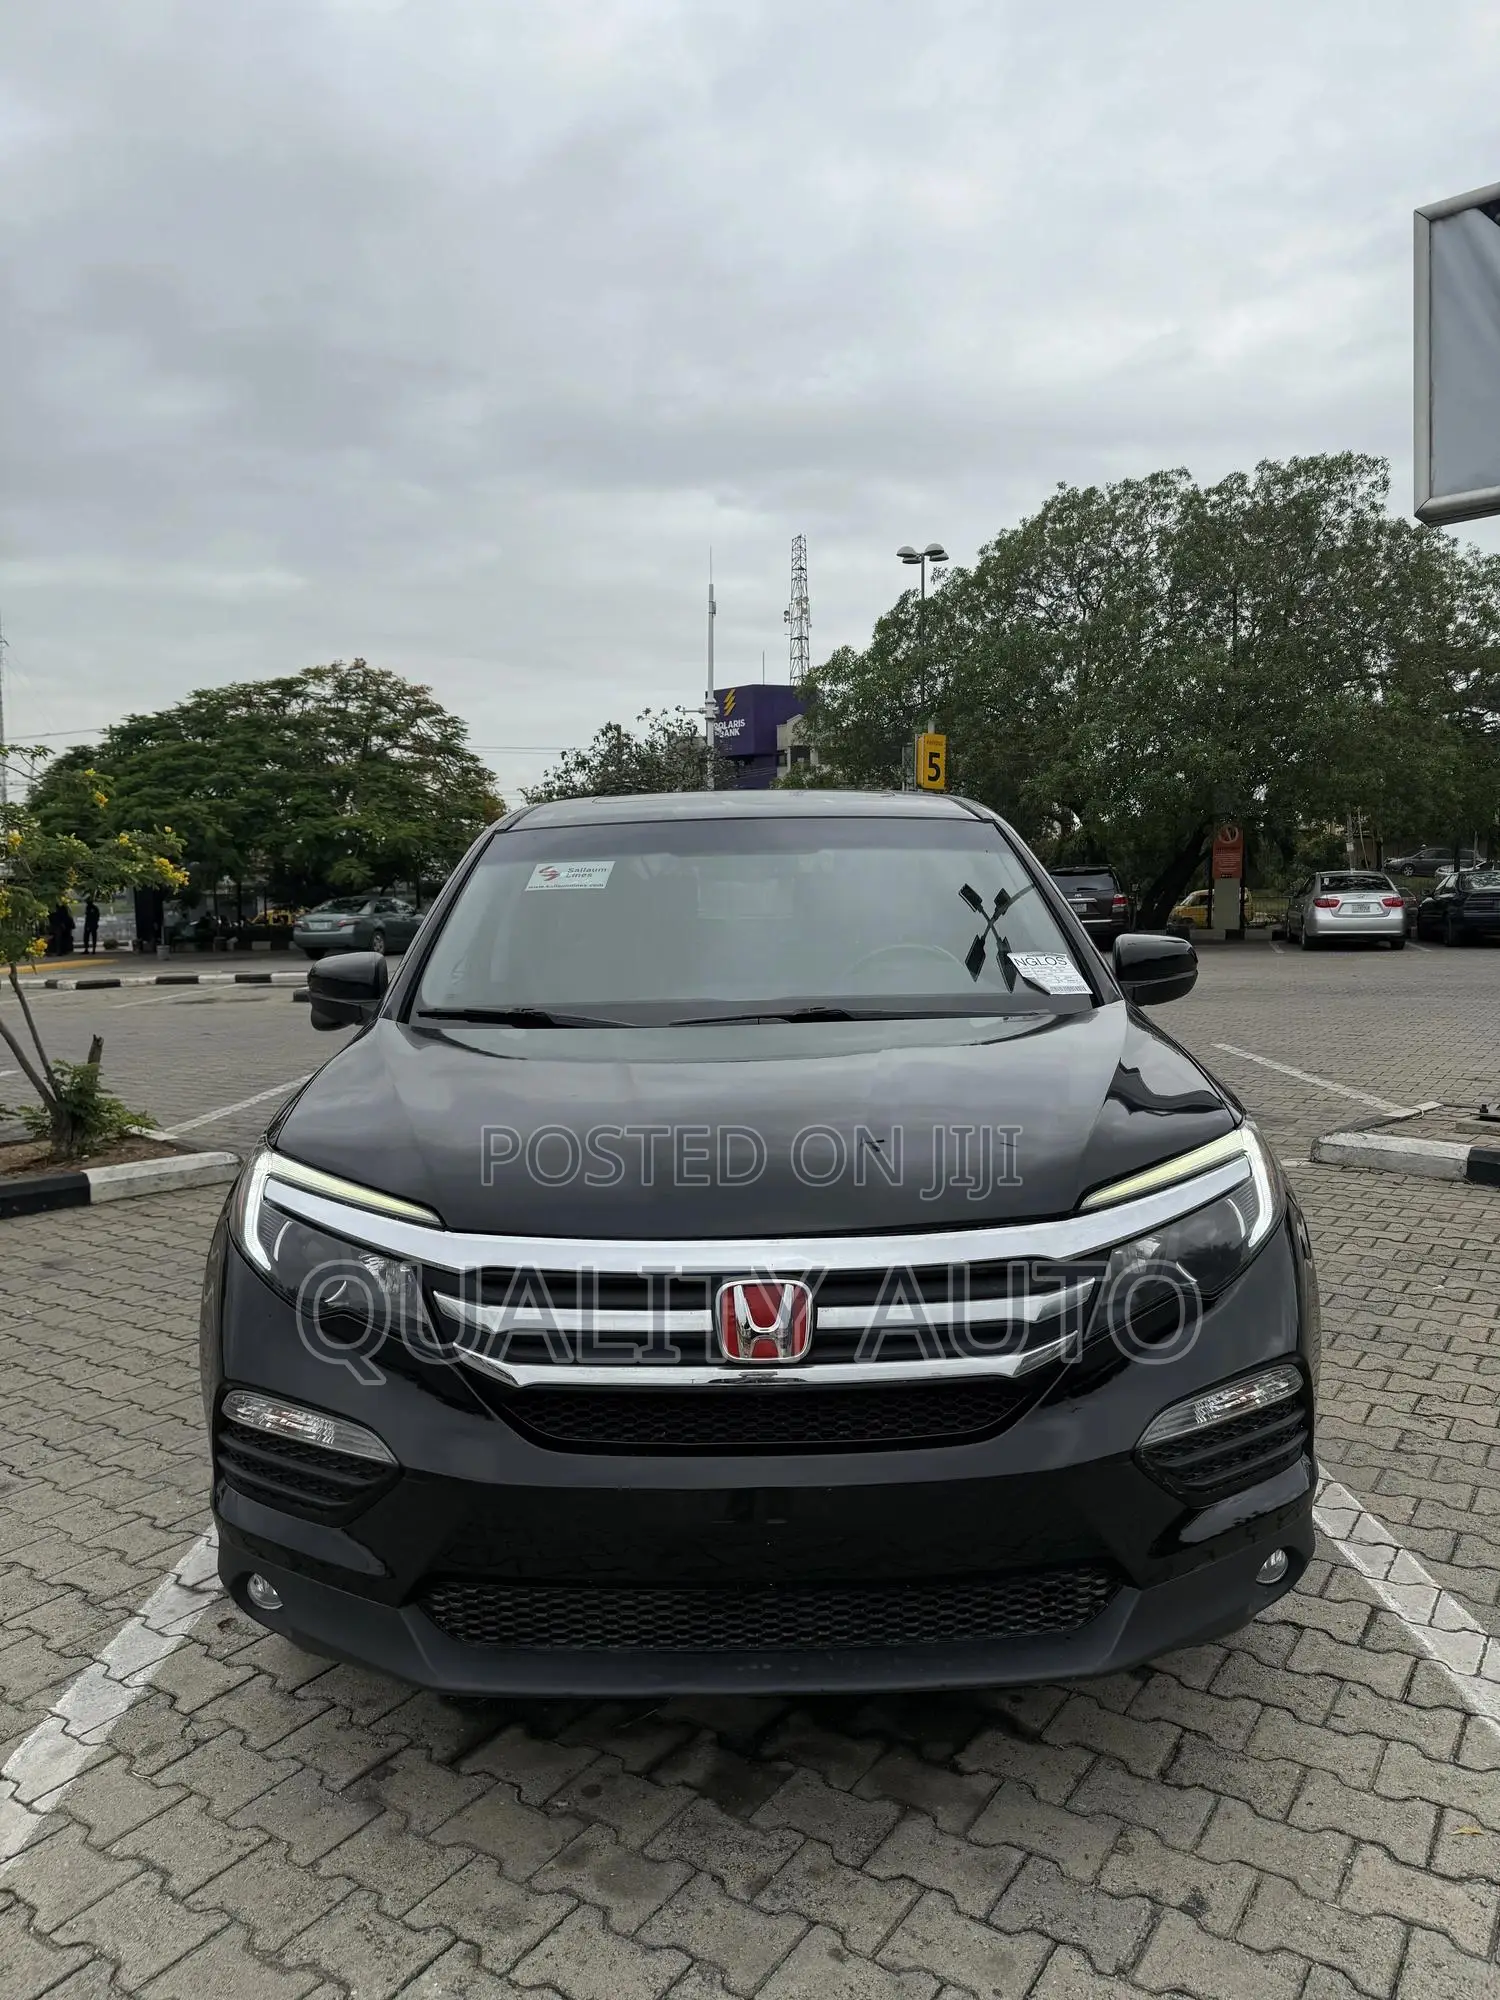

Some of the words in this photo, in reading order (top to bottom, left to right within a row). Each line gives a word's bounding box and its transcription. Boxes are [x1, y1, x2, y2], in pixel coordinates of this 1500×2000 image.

[720, 728, 740, 738] BANK
[927, 751, 941, 782] 5
[1013, 956, 1068, 967] NGLOS
